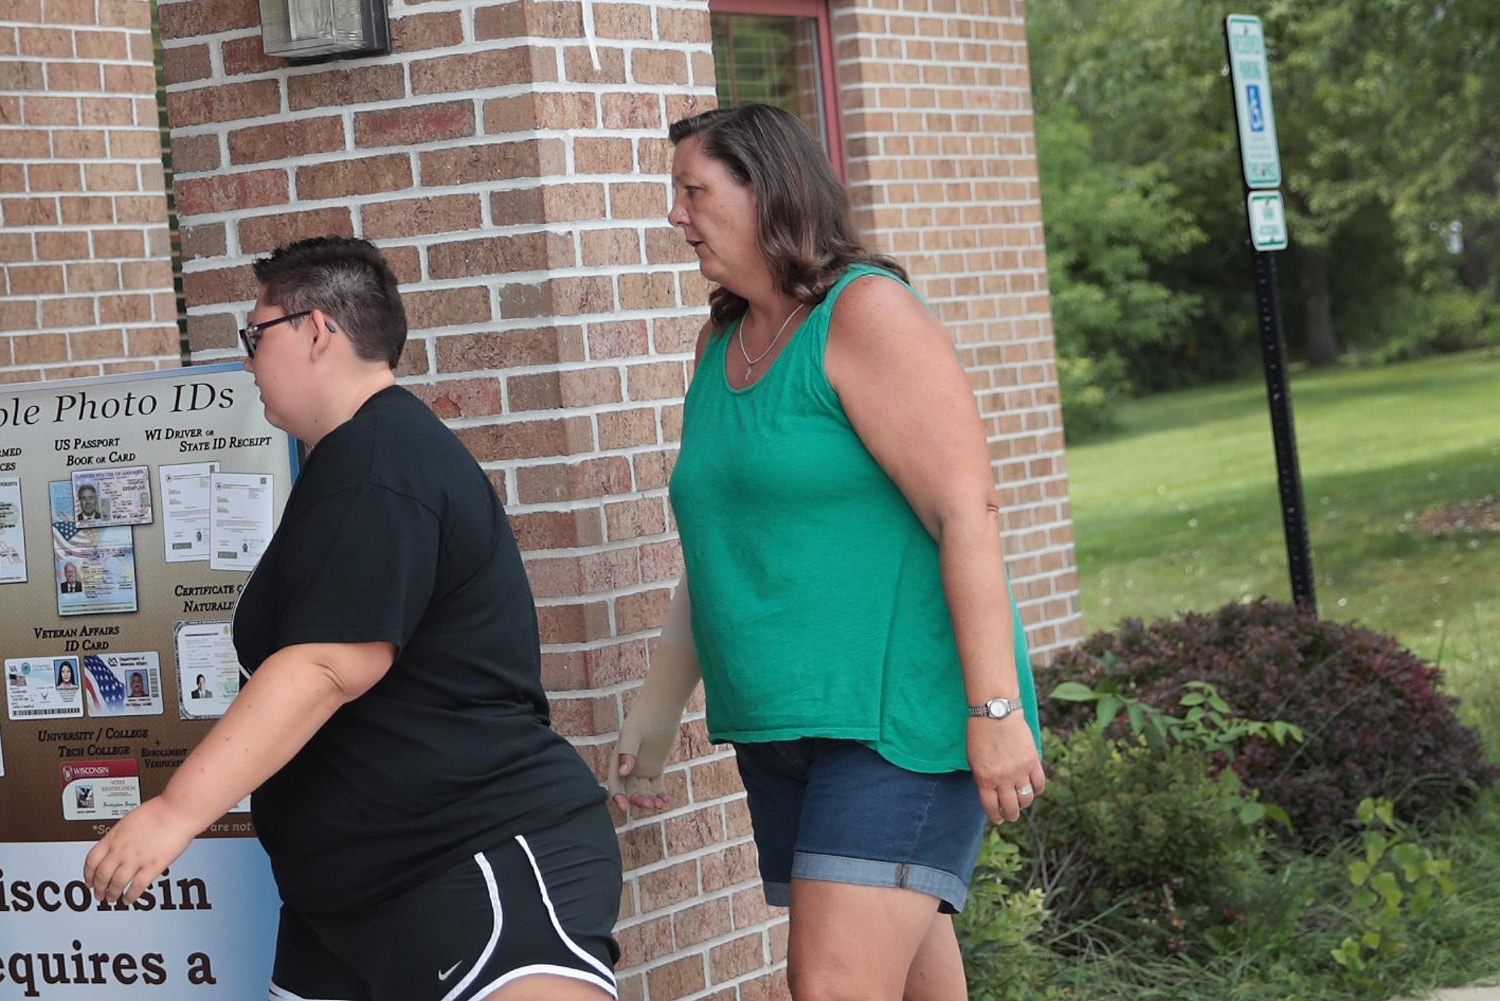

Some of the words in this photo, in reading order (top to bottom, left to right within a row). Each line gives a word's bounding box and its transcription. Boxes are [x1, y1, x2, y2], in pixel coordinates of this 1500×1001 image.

[52, 391, 158, 423] Photo
[169, 382, 235, 413] IDs
[145, 429, 161, 441] WI
[164, 428, 202, 440] DRIVER
[54, 439, 70, 450] US
[73, 437, 120, 449] PASSPORT
[180, 440, 210, 452] STATE
[212, 438, 226, 450] ID
[229, 436, 272, 449] RECEIPT
[66, 454, 93, 466] BOOK
[108, 452, 136, 464] CARD
[174, 584, 235, 596] CERTIFICATE
[34, 627, 77, 639] VETERAN
[79, 625, 120, 637] AFFAIRS
[65, 640, 80, 651] ID
[82, 639, 109, 650] CARD
[187, 951, 217, 985] a
